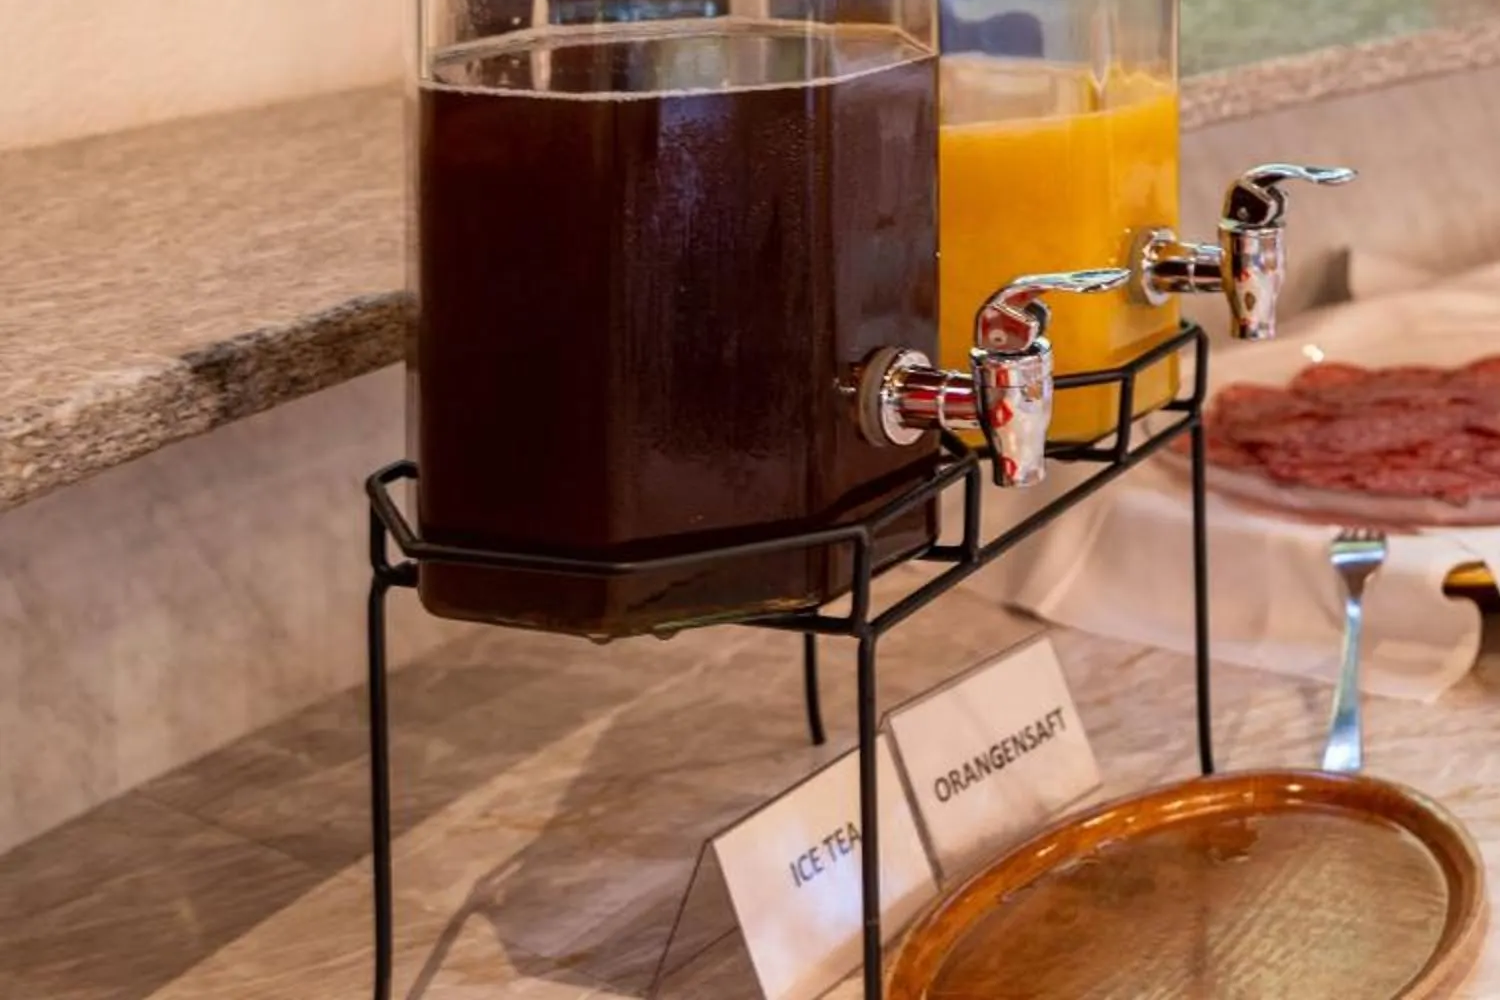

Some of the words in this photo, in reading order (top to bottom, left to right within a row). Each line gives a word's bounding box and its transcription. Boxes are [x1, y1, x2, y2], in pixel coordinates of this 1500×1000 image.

[933, 708, 1067, 803] ORANGENSAFT
[789, 845, 823, 888] ICE
[823, 822, 863, 864] TEA
